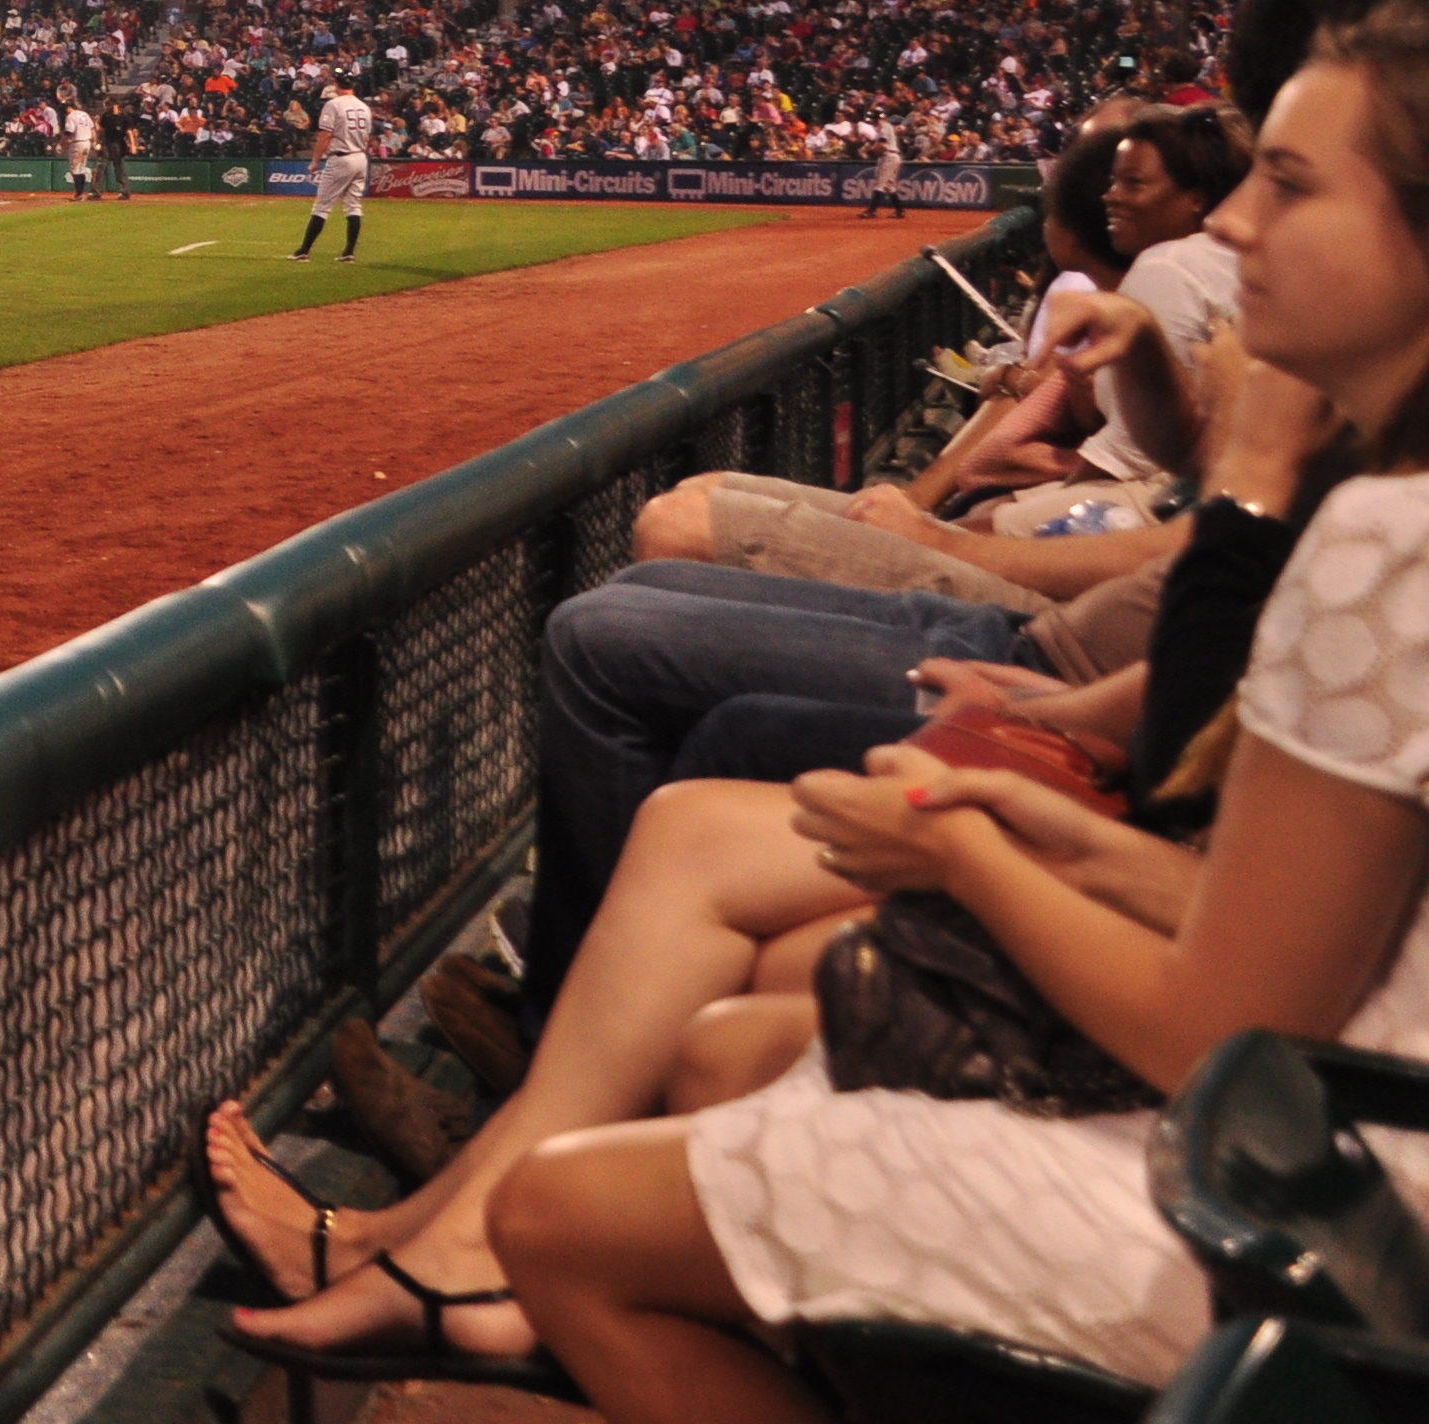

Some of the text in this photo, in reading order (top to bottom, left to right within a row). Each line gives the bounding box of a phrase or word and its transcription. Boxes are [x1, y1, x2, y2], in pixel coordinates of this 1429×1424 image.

[345, 108, 366, 131] 56
[370, 166, 464, 193] Budweiser
[518, 169, 656, 194] Mini-Circuits
[707, 171, 834, 197] Mini-Circuits
[843, 178, 878, 200] SN
[895, 179, 939, 201] SNY
[944, 181, 980, 203] SNY
